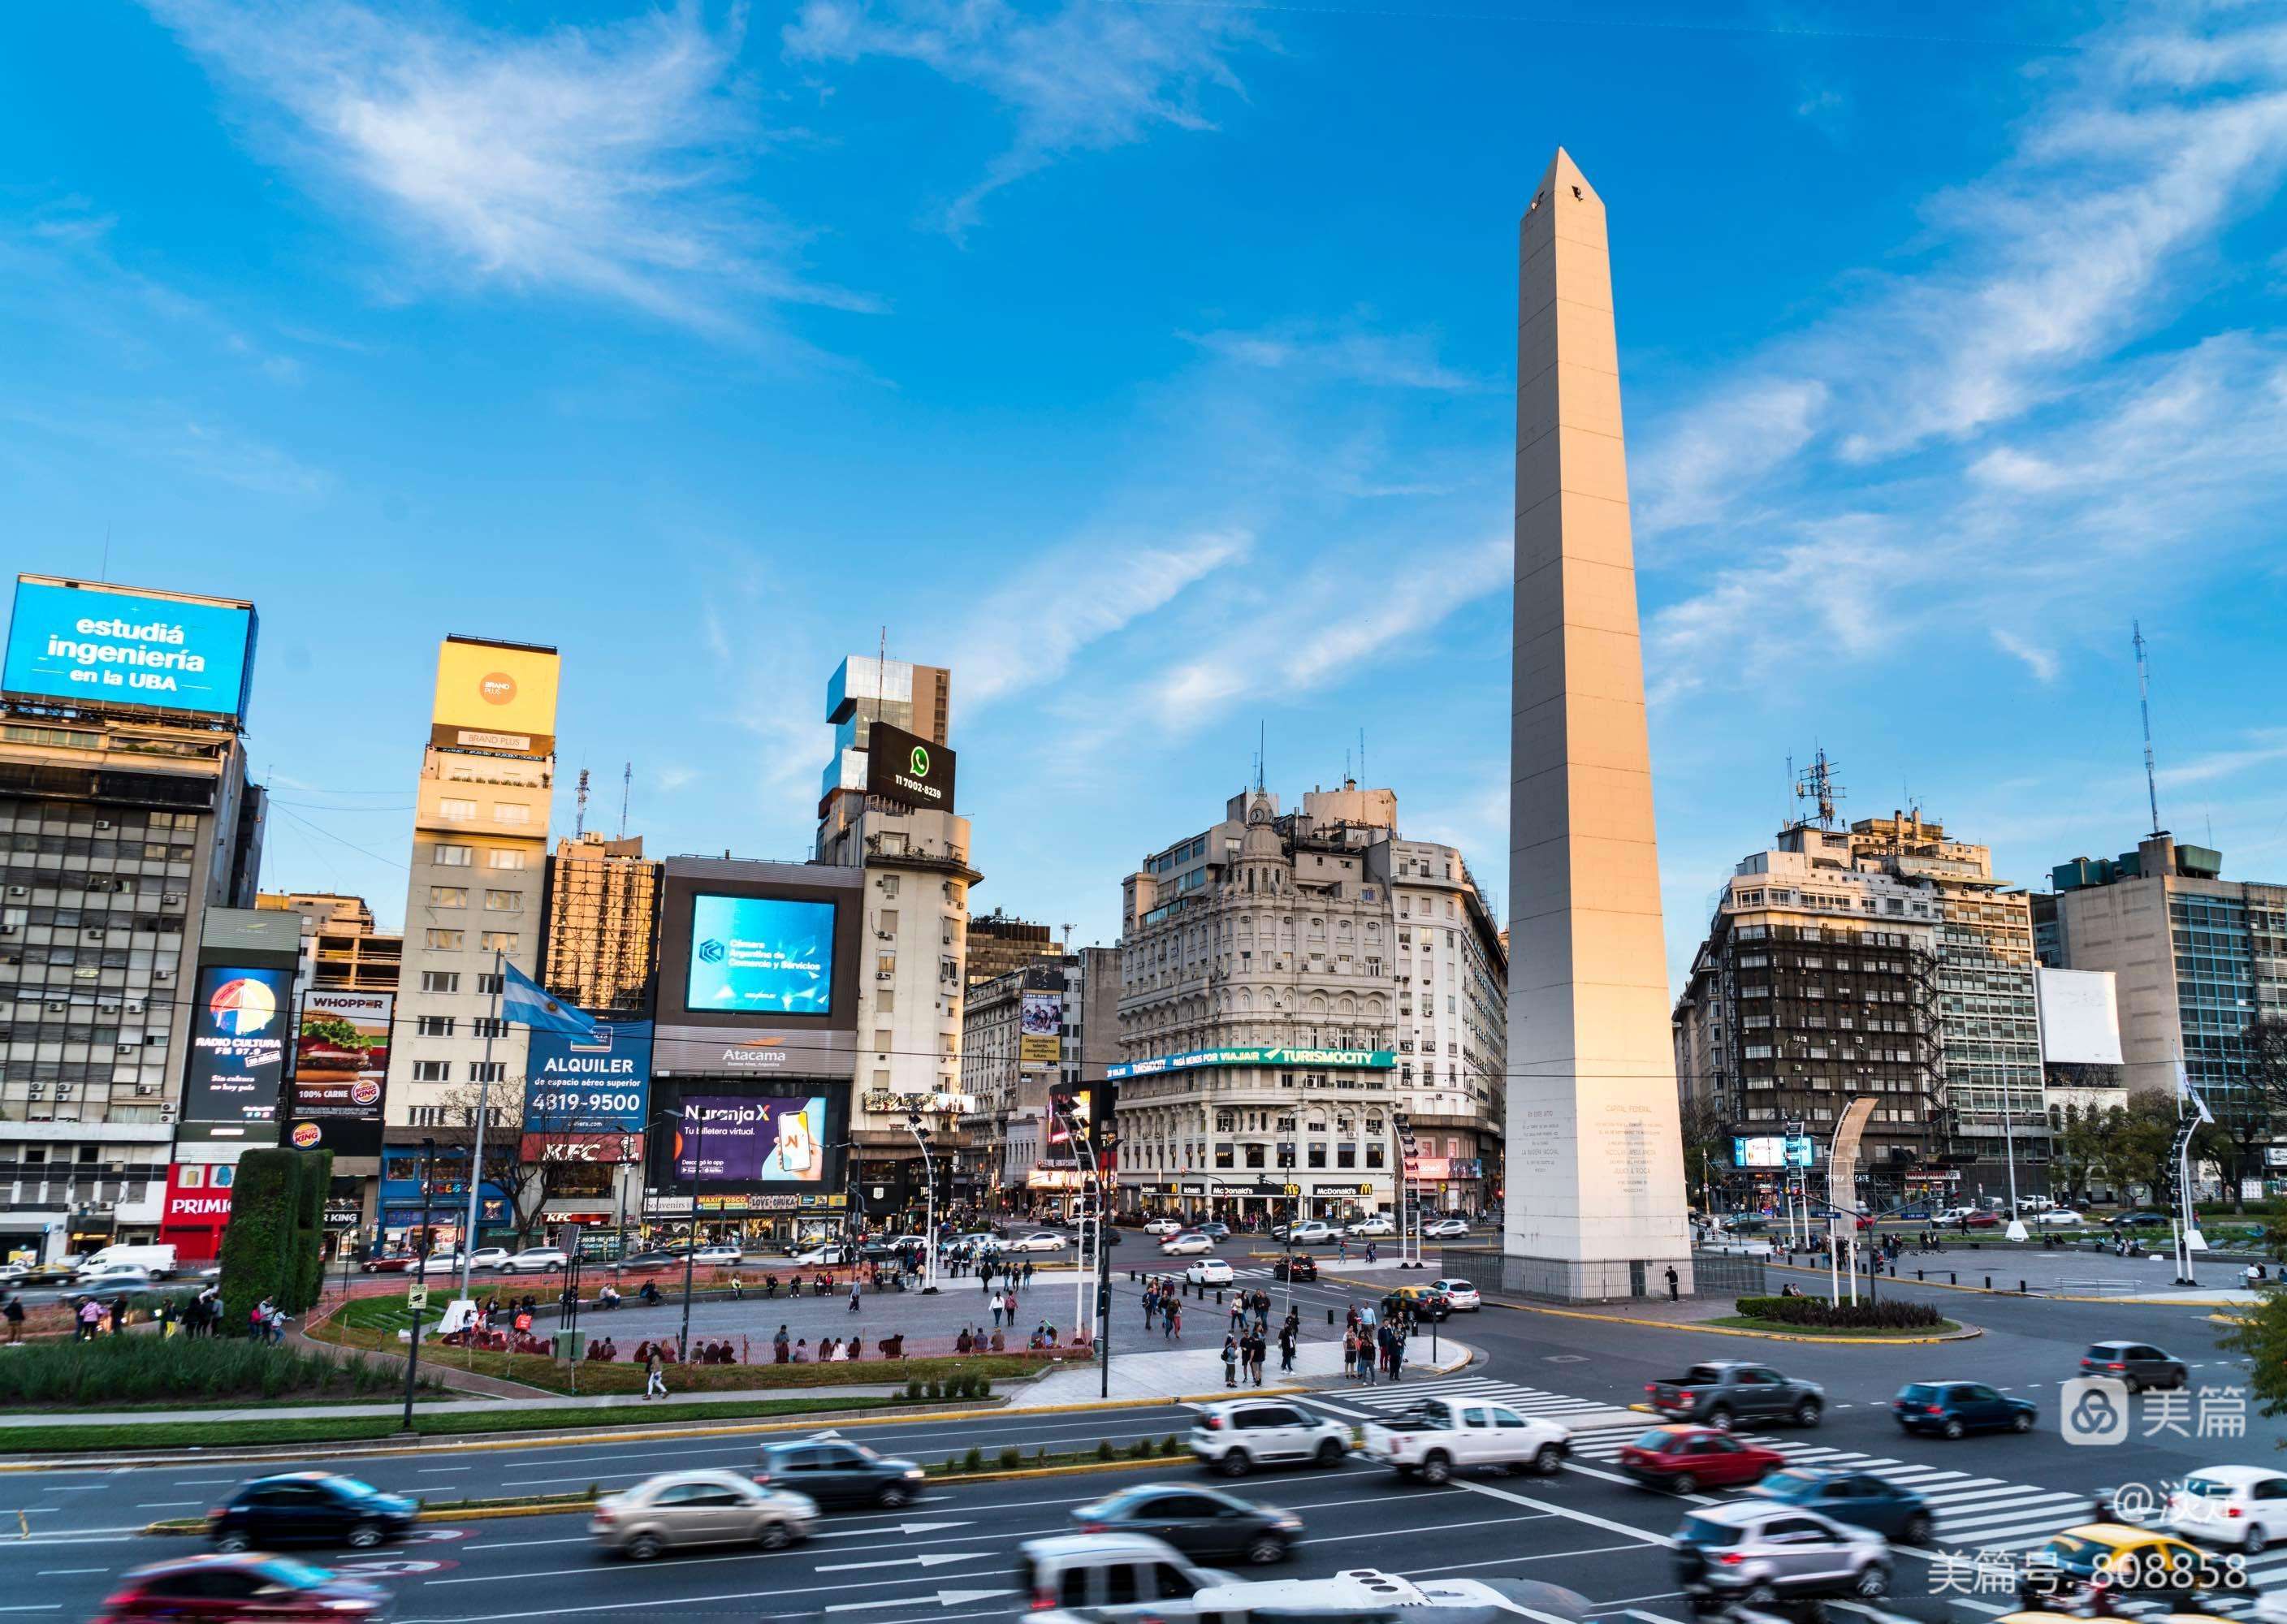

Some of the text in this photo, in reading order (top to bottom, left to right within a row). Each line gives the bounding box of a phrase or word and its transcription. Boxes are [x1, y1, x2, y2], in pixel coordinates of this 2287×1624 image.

[76, 618, 184, 645] estudiá
[47, 634, 205, 672] ingeniería
[70, 669, 177, 691] en la UBA
[485, 681, 510, 689] BRAND
[469, 734, 520, 746] BRAND PLUS
[895, 774, 941, 799] 11 7002-8239
[781, 961, 821, 970] Servicios
[313, 997, 383, 1009] WHOPPER
[196, 1037, 281, 1047] RADIO CULTURA
[722, 1049, 786, 1061] Atacama
[1186, 1054, 1203, 1065] MENOS
[1203, 1053, 1217, 1062] POR
[1219, 1052, 1260, 1061] VIAJAR
[1281, 1050, 1373, 1064] TURISMOCITY
[544, 1058, 633, 1073] ALQUILER
[547, 1078, 579, 1087] espacio
[581, 1078, 604, 1086] aéreo
[607, 1078, 641, 1088] superior
[356, 1088, 377, 1099] KING
[532, 1094, 640, 1111] 4819-9500
[685, 1104, 754, 1125] Naranja
[685, 1126, 694, 1134] Tu
[294, 1132, 318, 1143] KING
[542, 1143, 601, 1161] KFC
[1213, 1186, 1253, 1194] McDonald's
[751, 1198, 770, 1206] LOVE
[772, 1197, 795, 1206] CHUKA
[331, 1213, 357, 1221] KING
